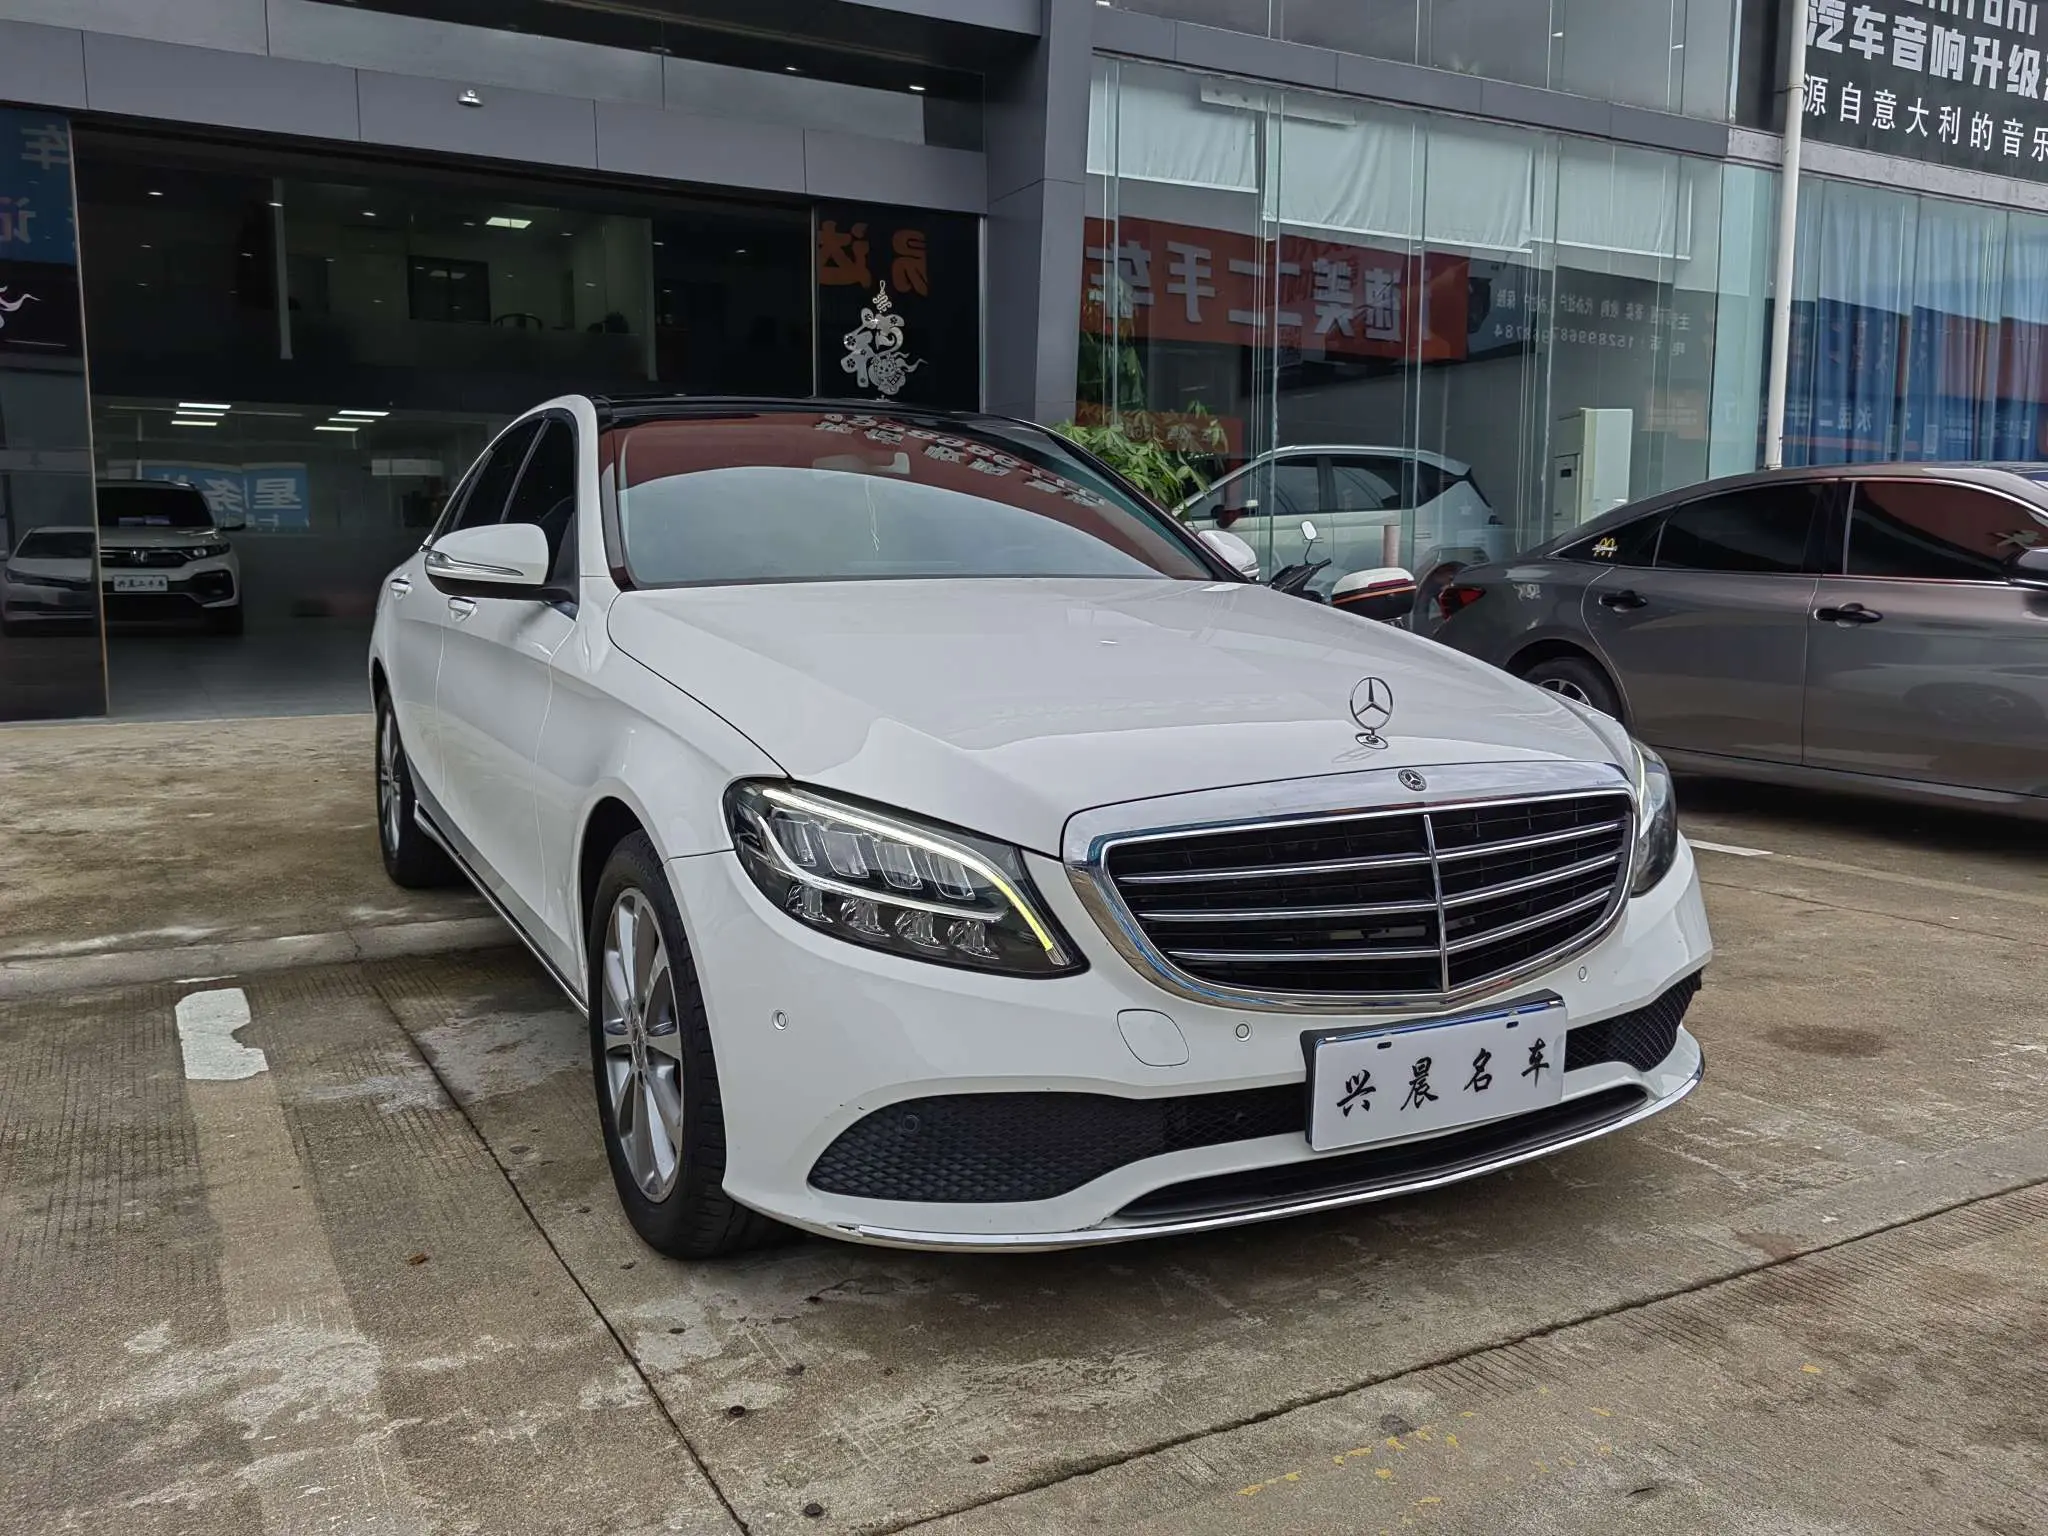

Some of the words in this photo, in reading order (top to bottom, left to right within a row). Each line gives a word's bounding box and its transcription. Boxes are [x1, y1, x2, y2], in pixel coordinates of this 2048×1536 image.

[1806, 0, 2048, 101] 汽车音响升级
[1803, 73, 2048, 162] 源自意大利的音乐
[1337, 1038, 1549, 1117] 兴晨名车
